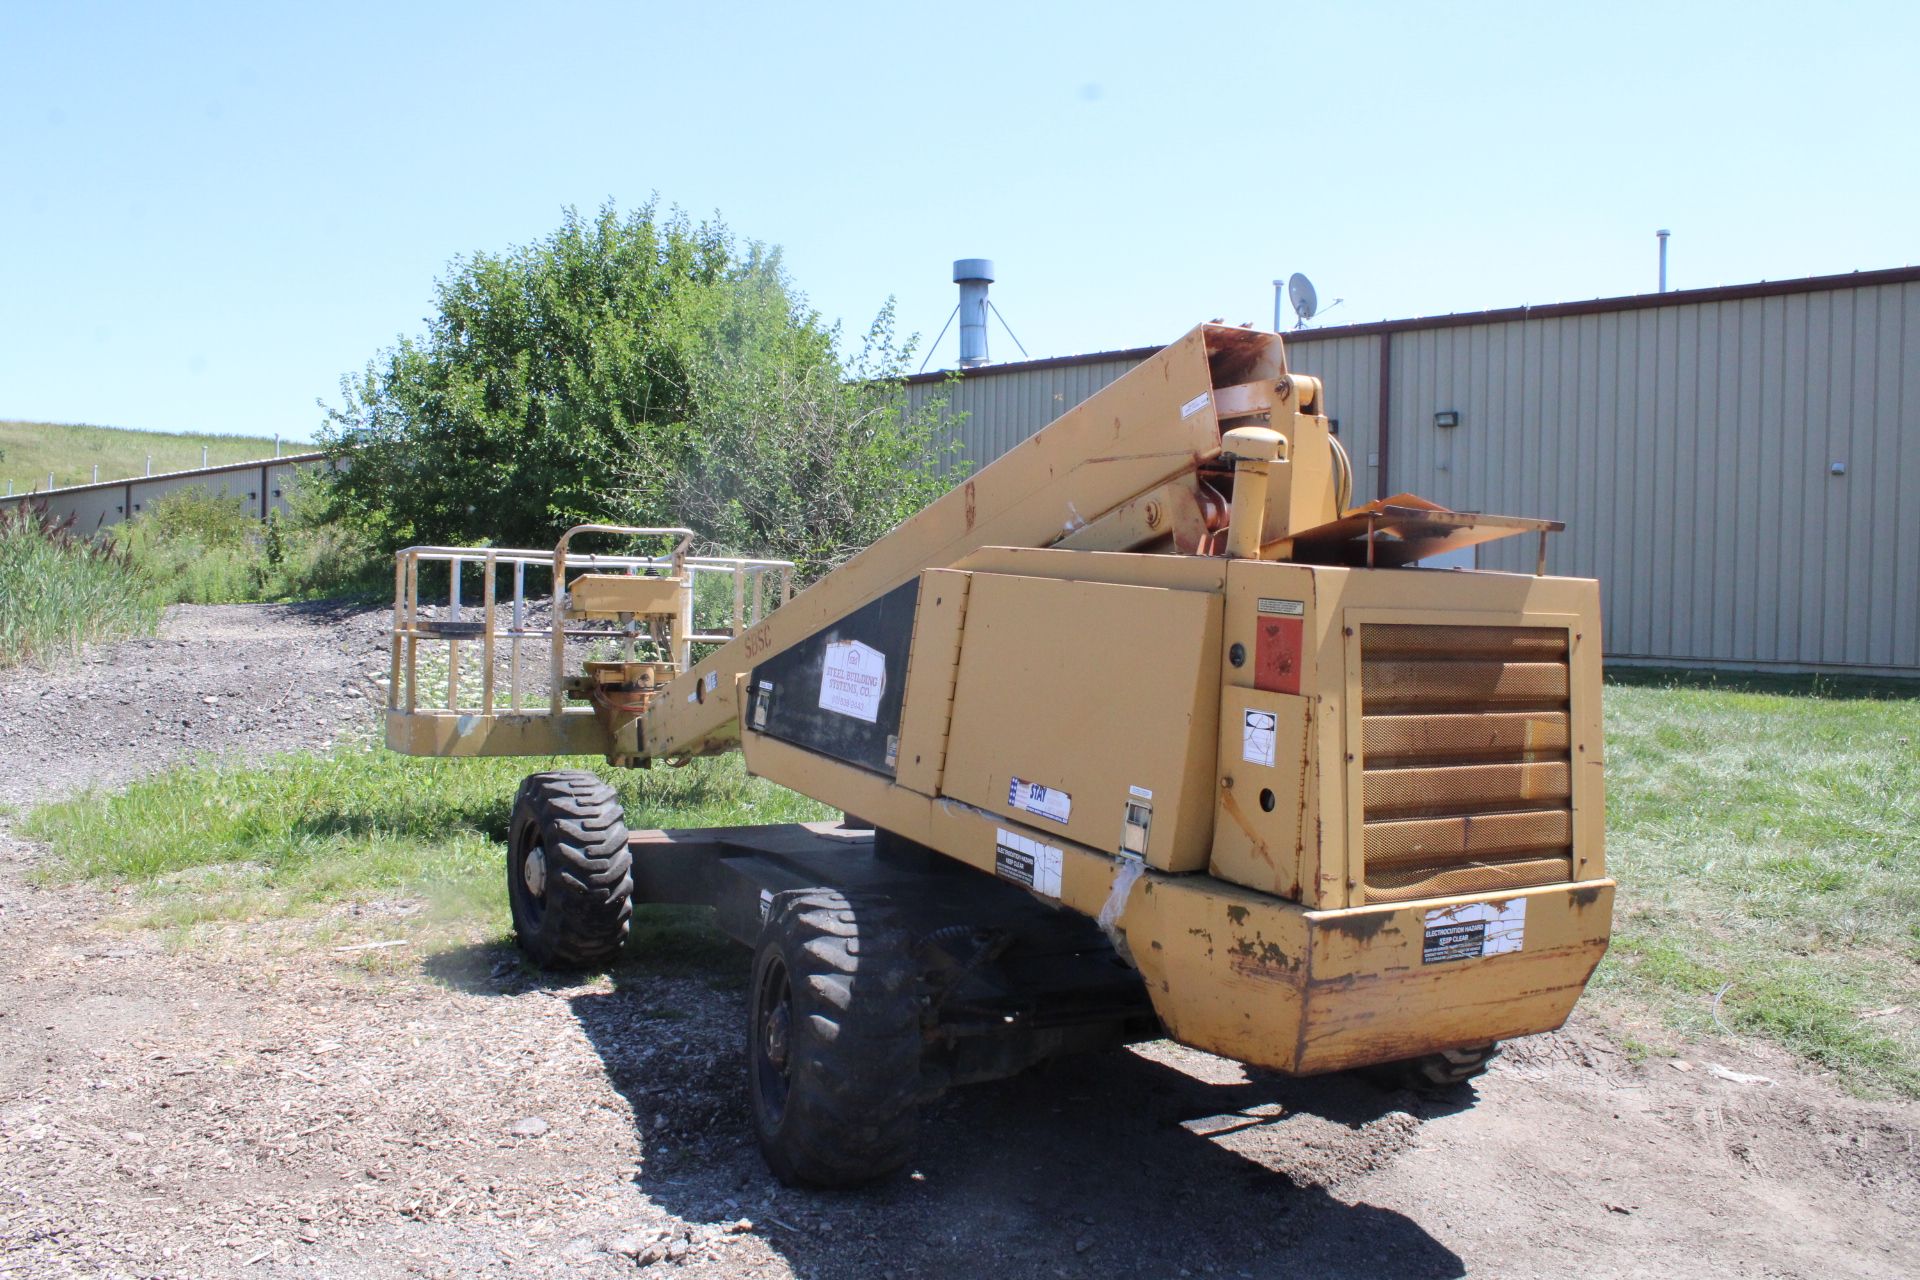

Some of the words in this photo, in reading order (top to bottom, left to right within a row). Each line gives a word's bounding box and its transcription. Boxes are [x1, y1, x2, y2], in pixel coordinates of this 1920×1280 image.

[826, 666, 845, 679] STEEL
[846, 671, 878, 687] BUILDING
[829, 679, 859, 696] SYSTEMS,
[1030, 784, 1047, 802] STAY
[997, 846, 1021, 860] ELECTROCUTION
[1021, 856, 1034, 865] HAZARD
[1005, 857, 1013, 865] KEEP
[1013, 860, 1024, 869] CLEAR
[1425, 927, 1464, 938] ELECTROCUTION
[1464, 923, 1484, 933] HAZARD
[1439, 936, 1453, 945] KEEP
[1453, 934, 1469, 943] CLEAR
